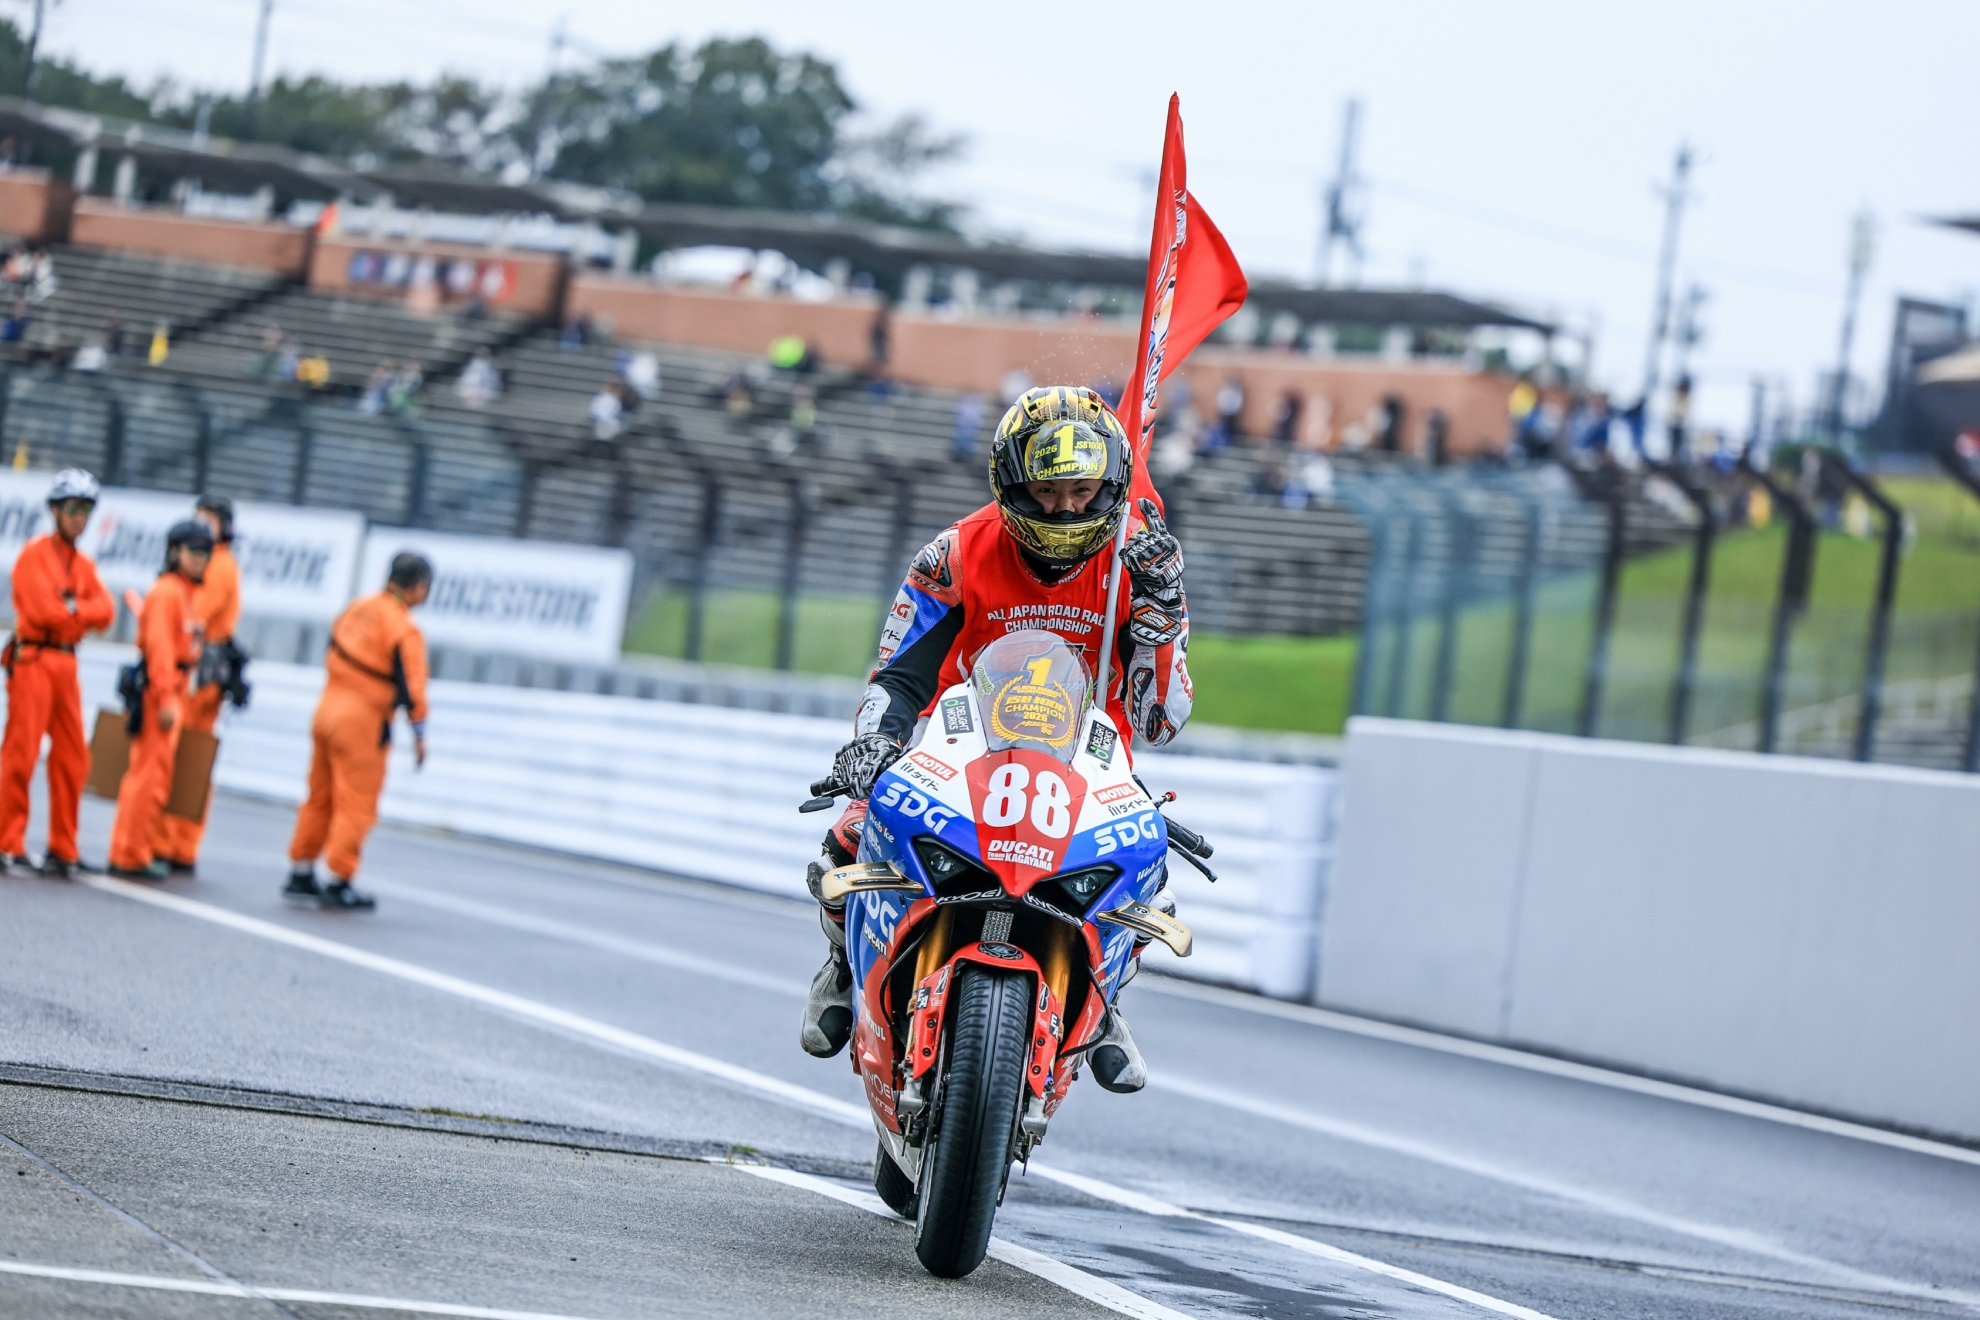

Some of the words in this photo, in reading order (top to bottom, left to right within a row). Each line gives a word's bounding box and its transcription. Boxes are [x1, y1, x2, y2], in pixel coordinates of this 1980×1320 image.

[1034, 444, 1057, 459] 2026
[1053, 425, 1078, 464] 1
[1074, 441, 1103, 451] JSB1000
[1036, 462, 1098, 481] CHAMPION
[987, 608, 1006, 620] ALL
[1008, 604, 1047, 619] JAPAN
[1048, 604, 1080, 619] ROAD
[1081, 610, 1106, 627] RAC
[1004, 618, 1092, 635] CHAMPIONSHIP
[1027, 657, 1052, 686] 1
[946, 707, 959, 730] WORKS
[1005, 703, 1065, 722] CHAMPION
[1023, 711, 1047, 722] 2026
[1101, 729, 1114, 751] WORKS
[912, 754, 954, 779] MOTUL
[982, 763, 1071, 839] 88
[1096, 784, 1137, 802] MOTUL
[877, 782, 959, 835] SDG
[1094, 811, 1159, 857] SDG
[987, 839, 1055, 862] DUCATI
[1005, 852, 1053, 872] KAGAYAMA
[937, 886, 1002, 903] KYOEI
[859, 890, 899, 947] DG
[863, 921, 887, 956] DUCATI
